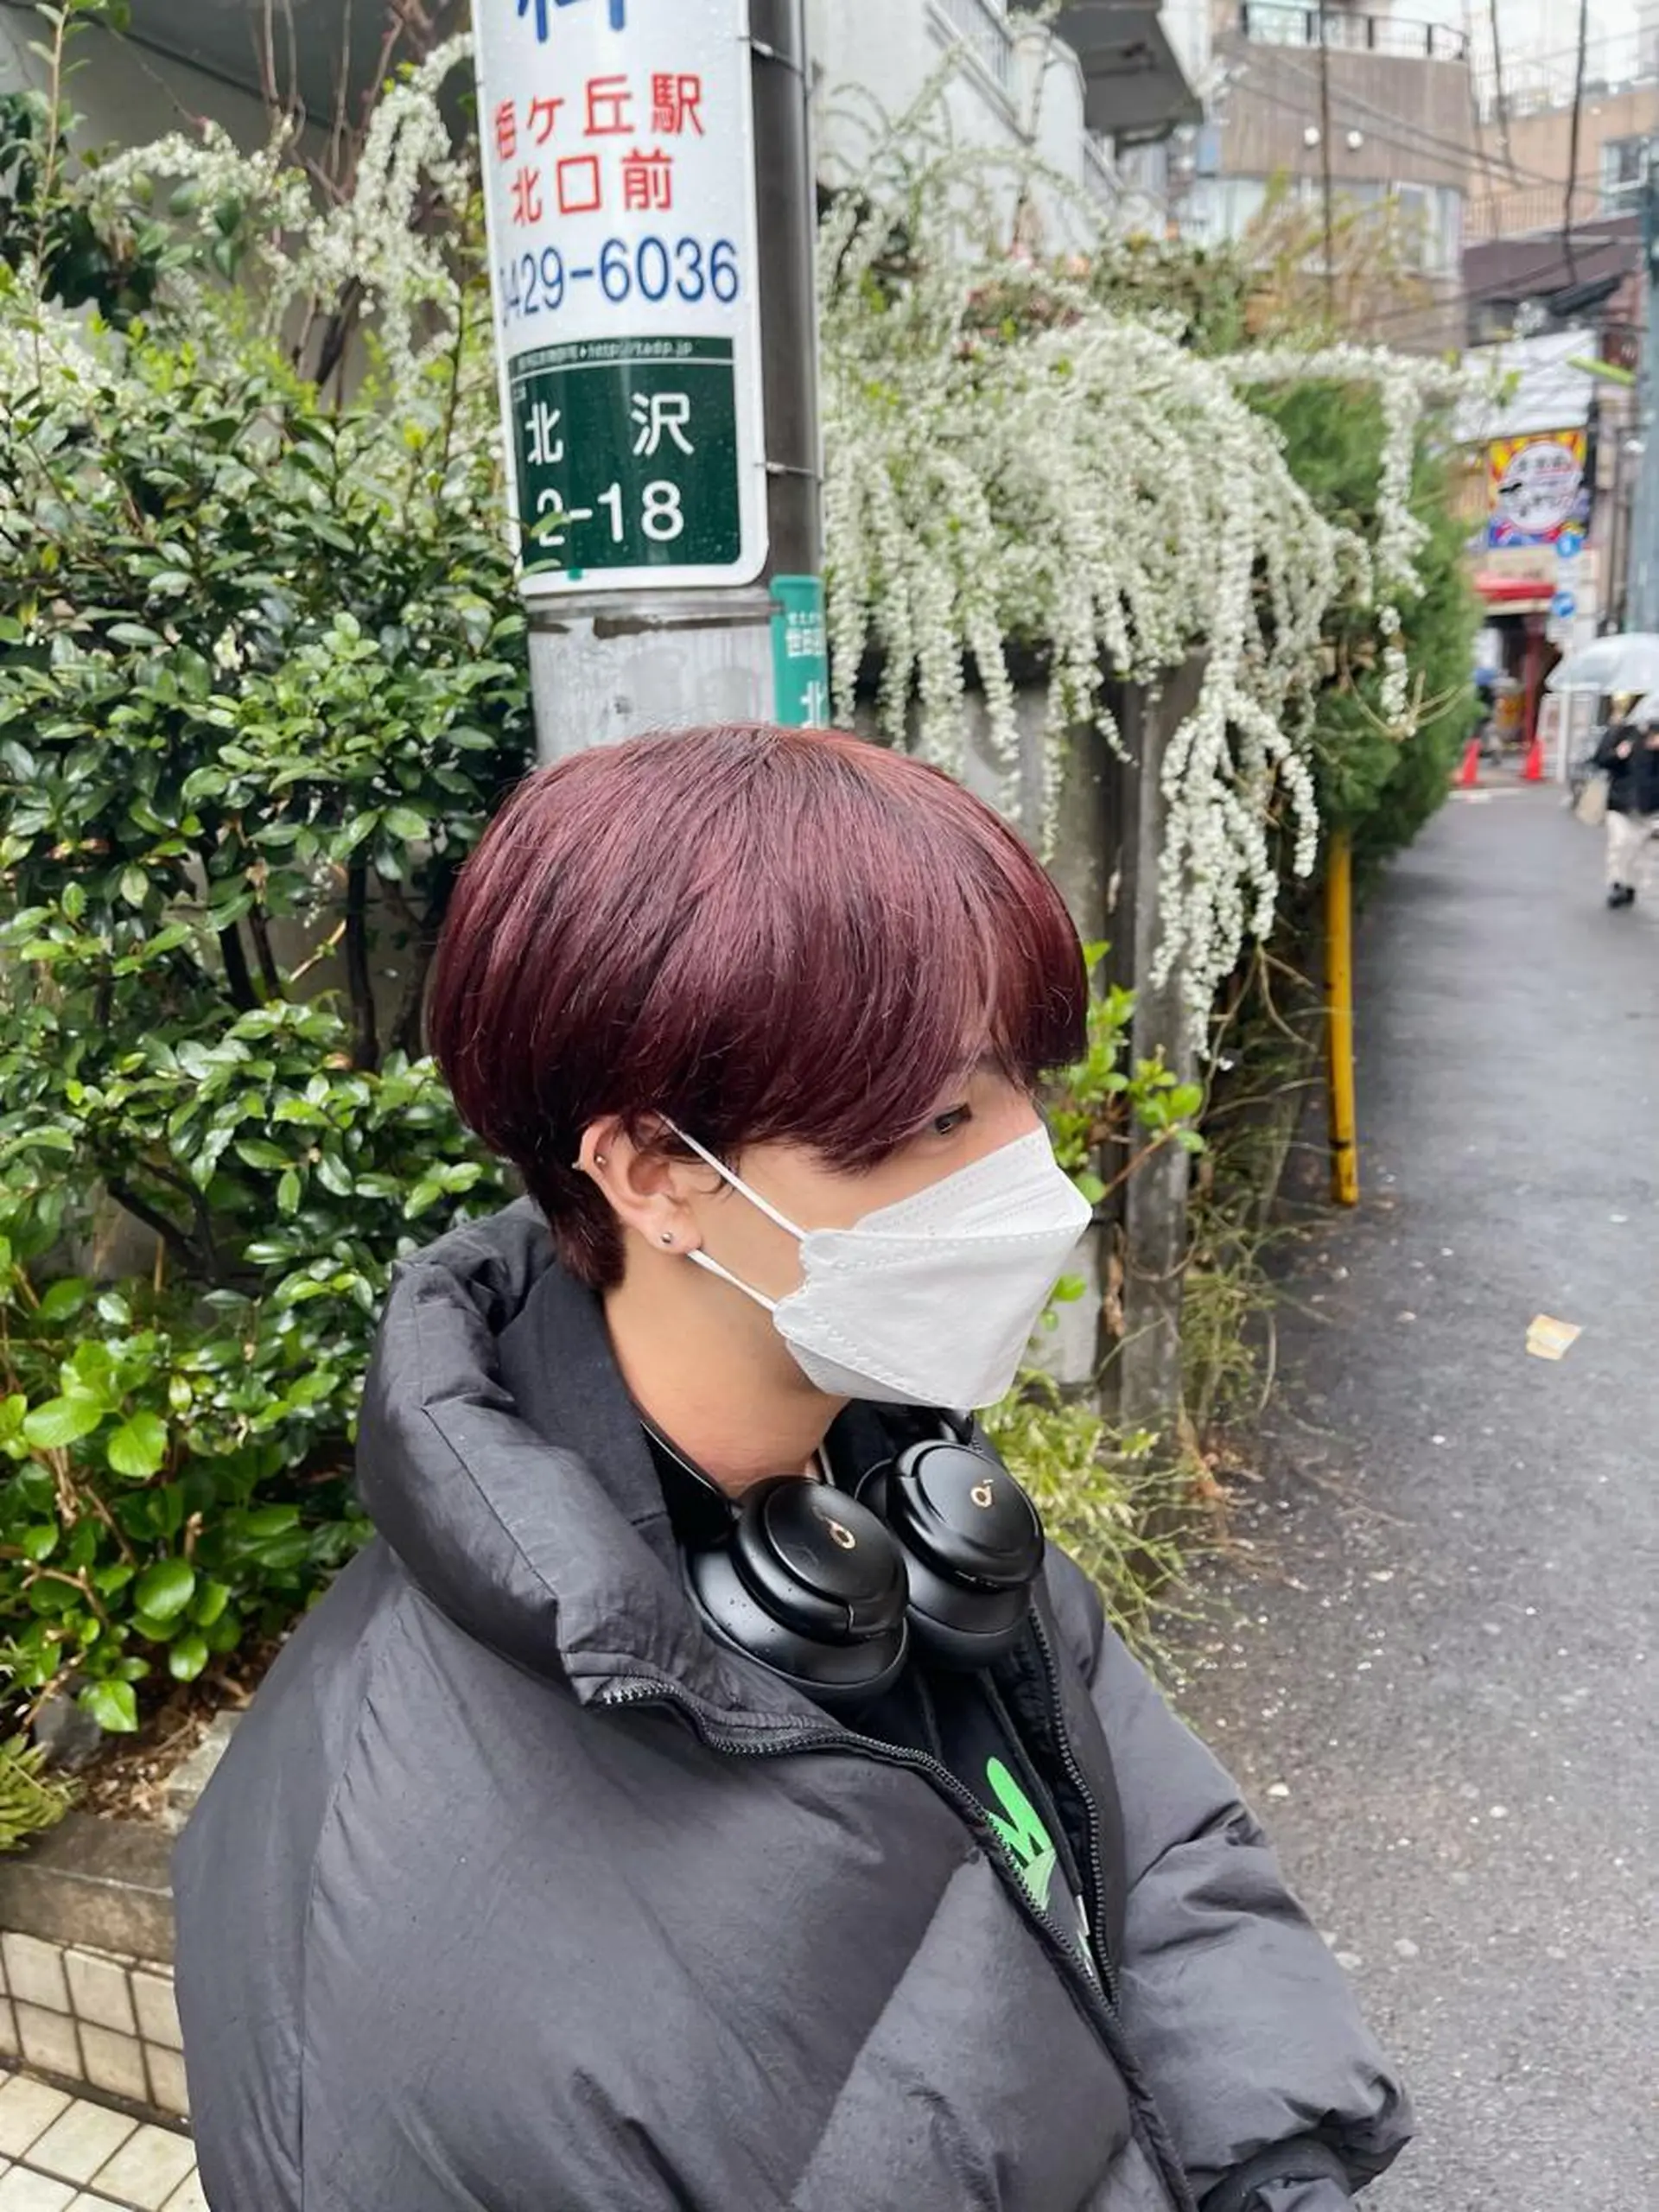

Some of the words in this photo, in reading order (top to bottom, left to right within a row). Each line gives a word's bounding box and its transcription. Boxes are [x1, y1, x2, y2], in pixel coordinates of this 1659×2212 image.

[511, 147, 673, 226] 北口前
[537, 480, 685, 548] 2-18
